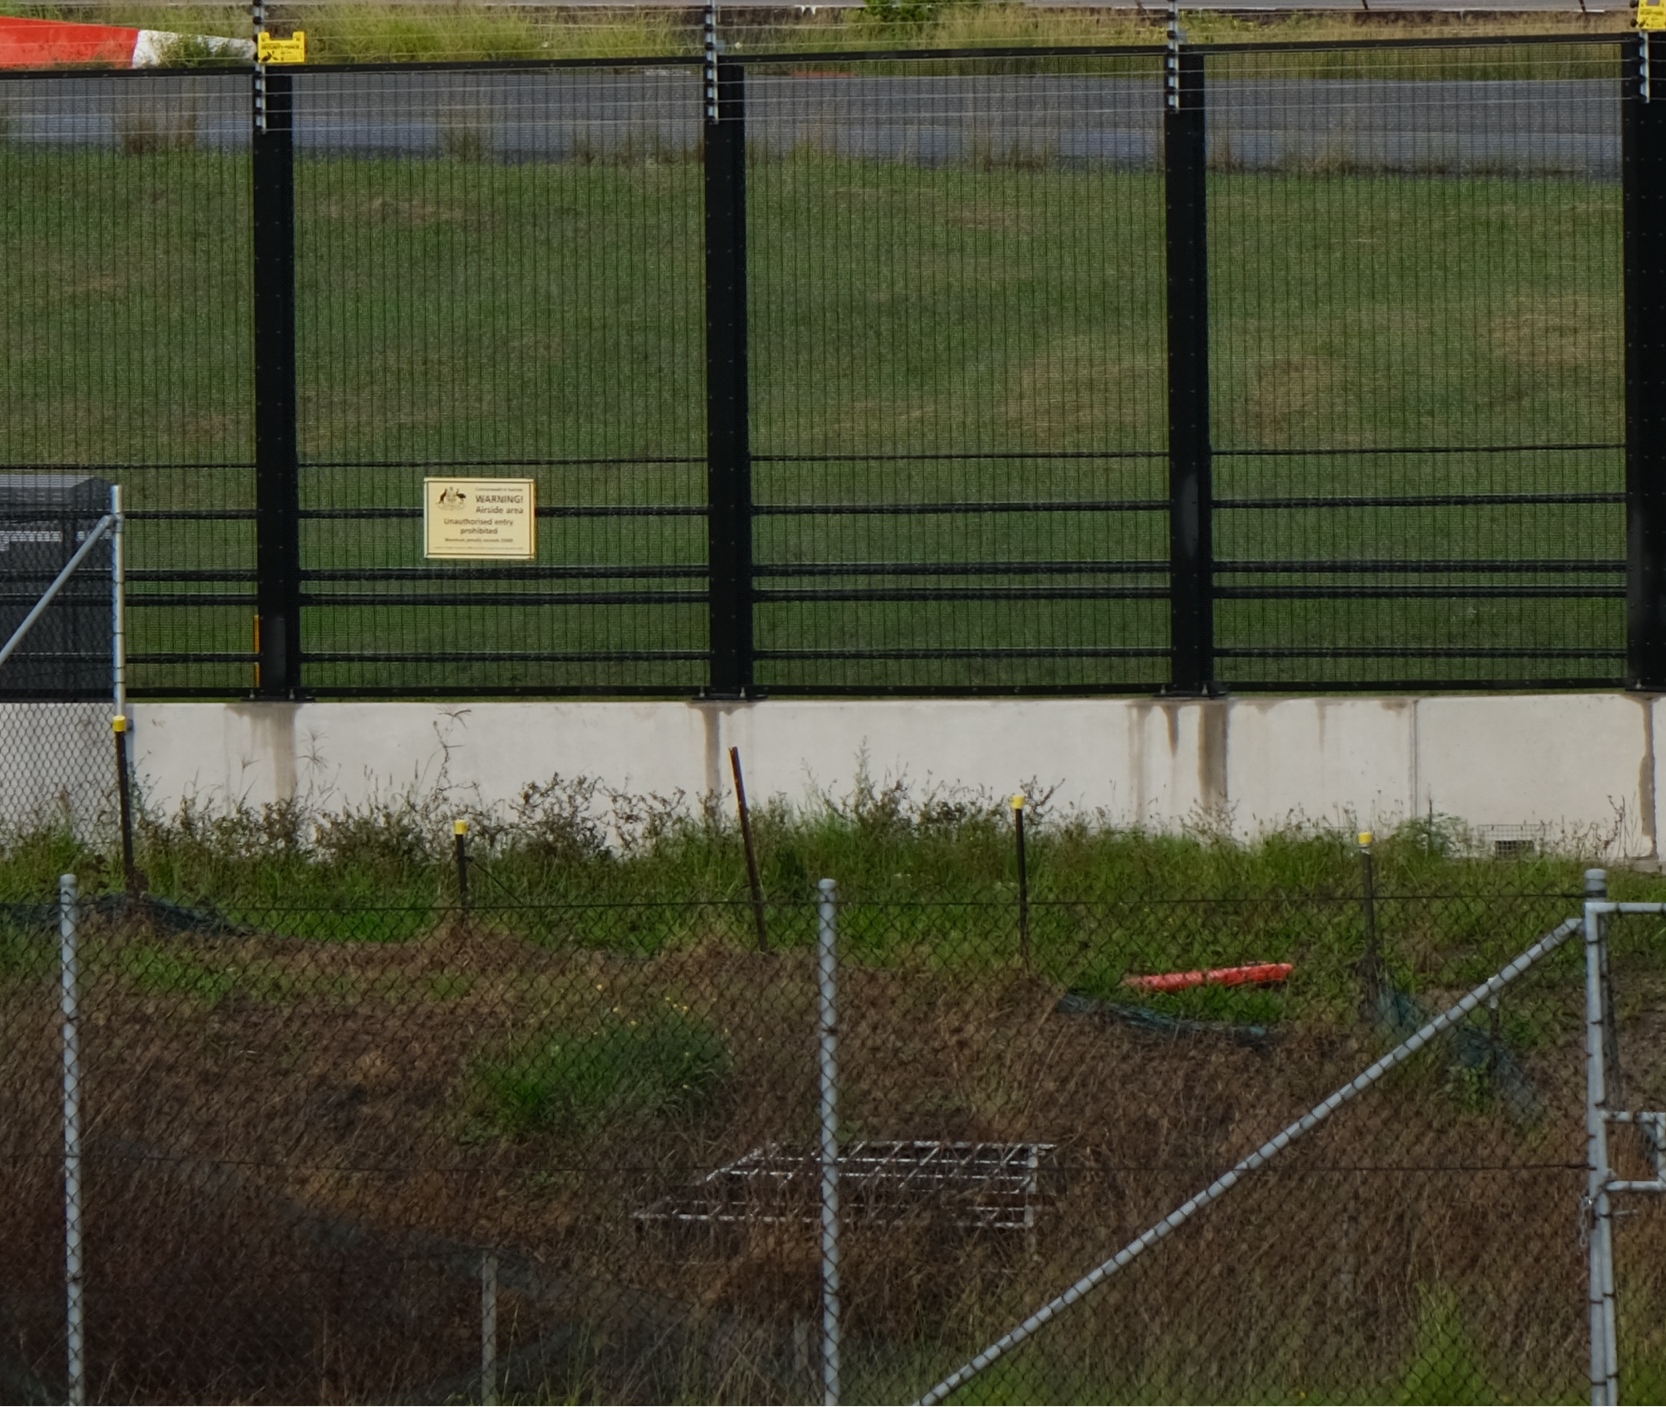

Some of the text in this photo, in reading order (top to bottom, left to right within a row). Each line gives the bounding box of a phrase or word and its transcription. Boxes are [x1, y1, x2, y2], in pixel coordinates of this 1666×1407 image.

[475, 495, 524, 503] WARNING!
[475, 506, 504, 514] Airside
[494, 519, 514, 527] entry
